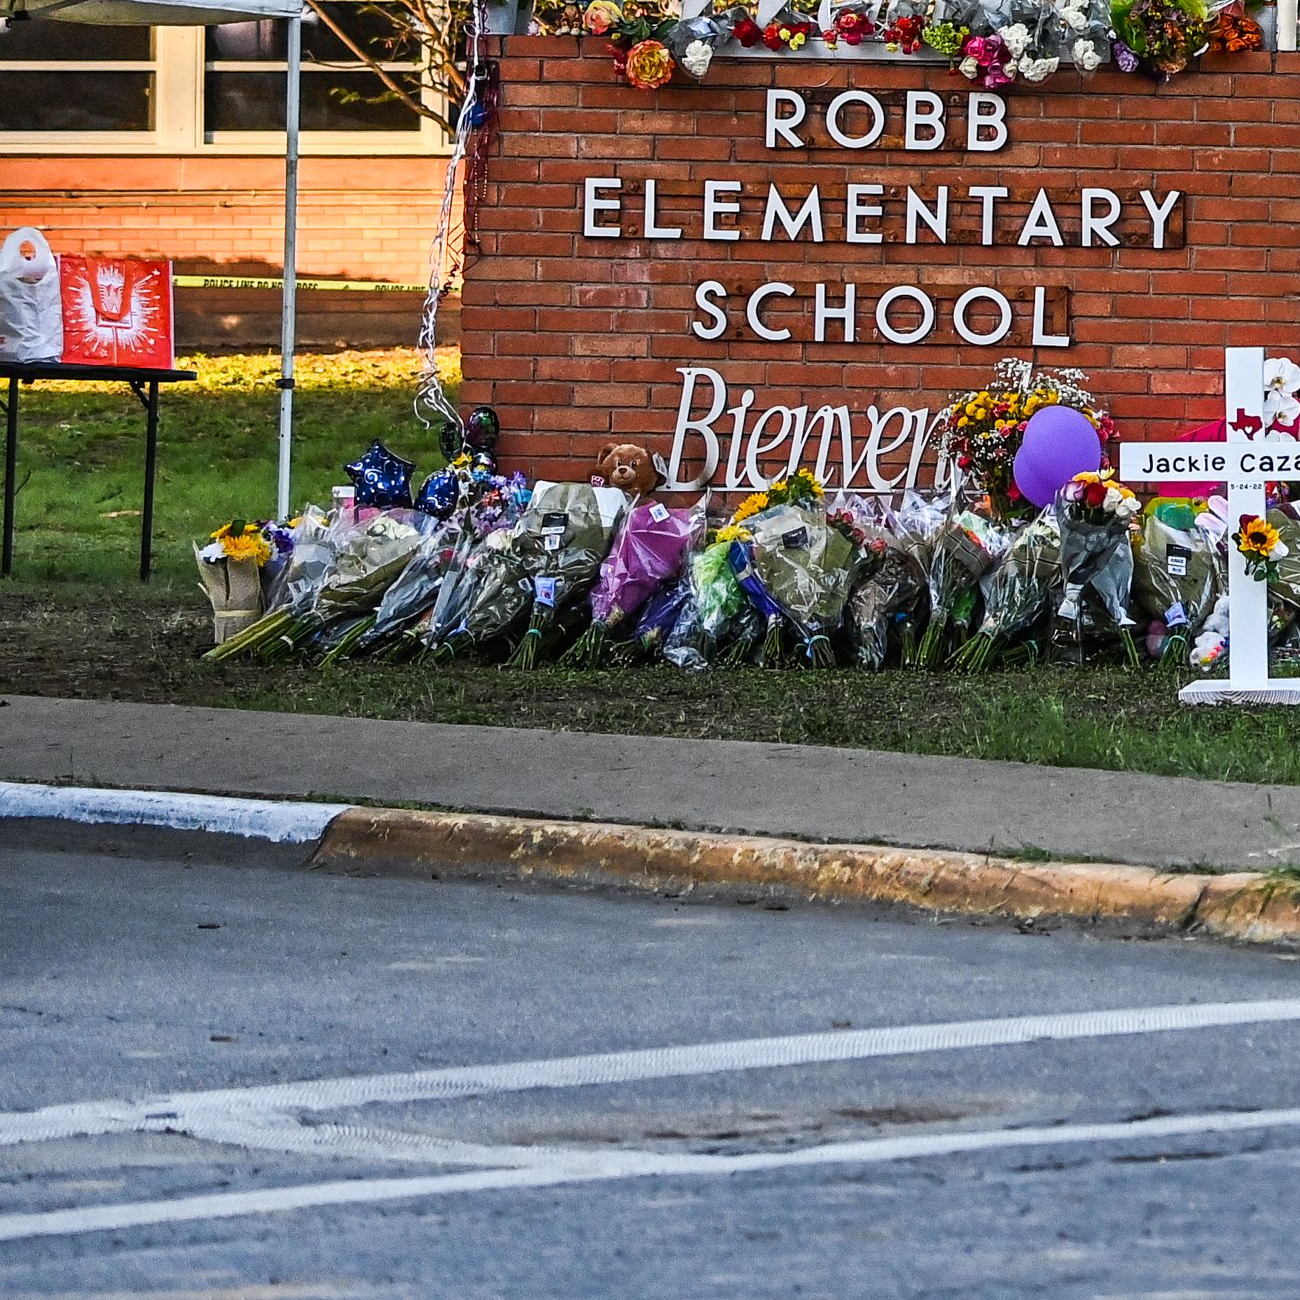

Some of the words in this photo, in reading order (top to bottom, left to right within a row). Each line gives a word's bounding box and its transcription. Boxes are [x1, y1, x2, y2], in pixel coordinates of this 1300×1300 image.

[765, 89, 1008, 150] ROBB
[584, 177, 1180, 248] ELEMENTARY
[692, 280, 1070, 347] SCHOOL
[1142, 453, 1226, 474] Jackie
